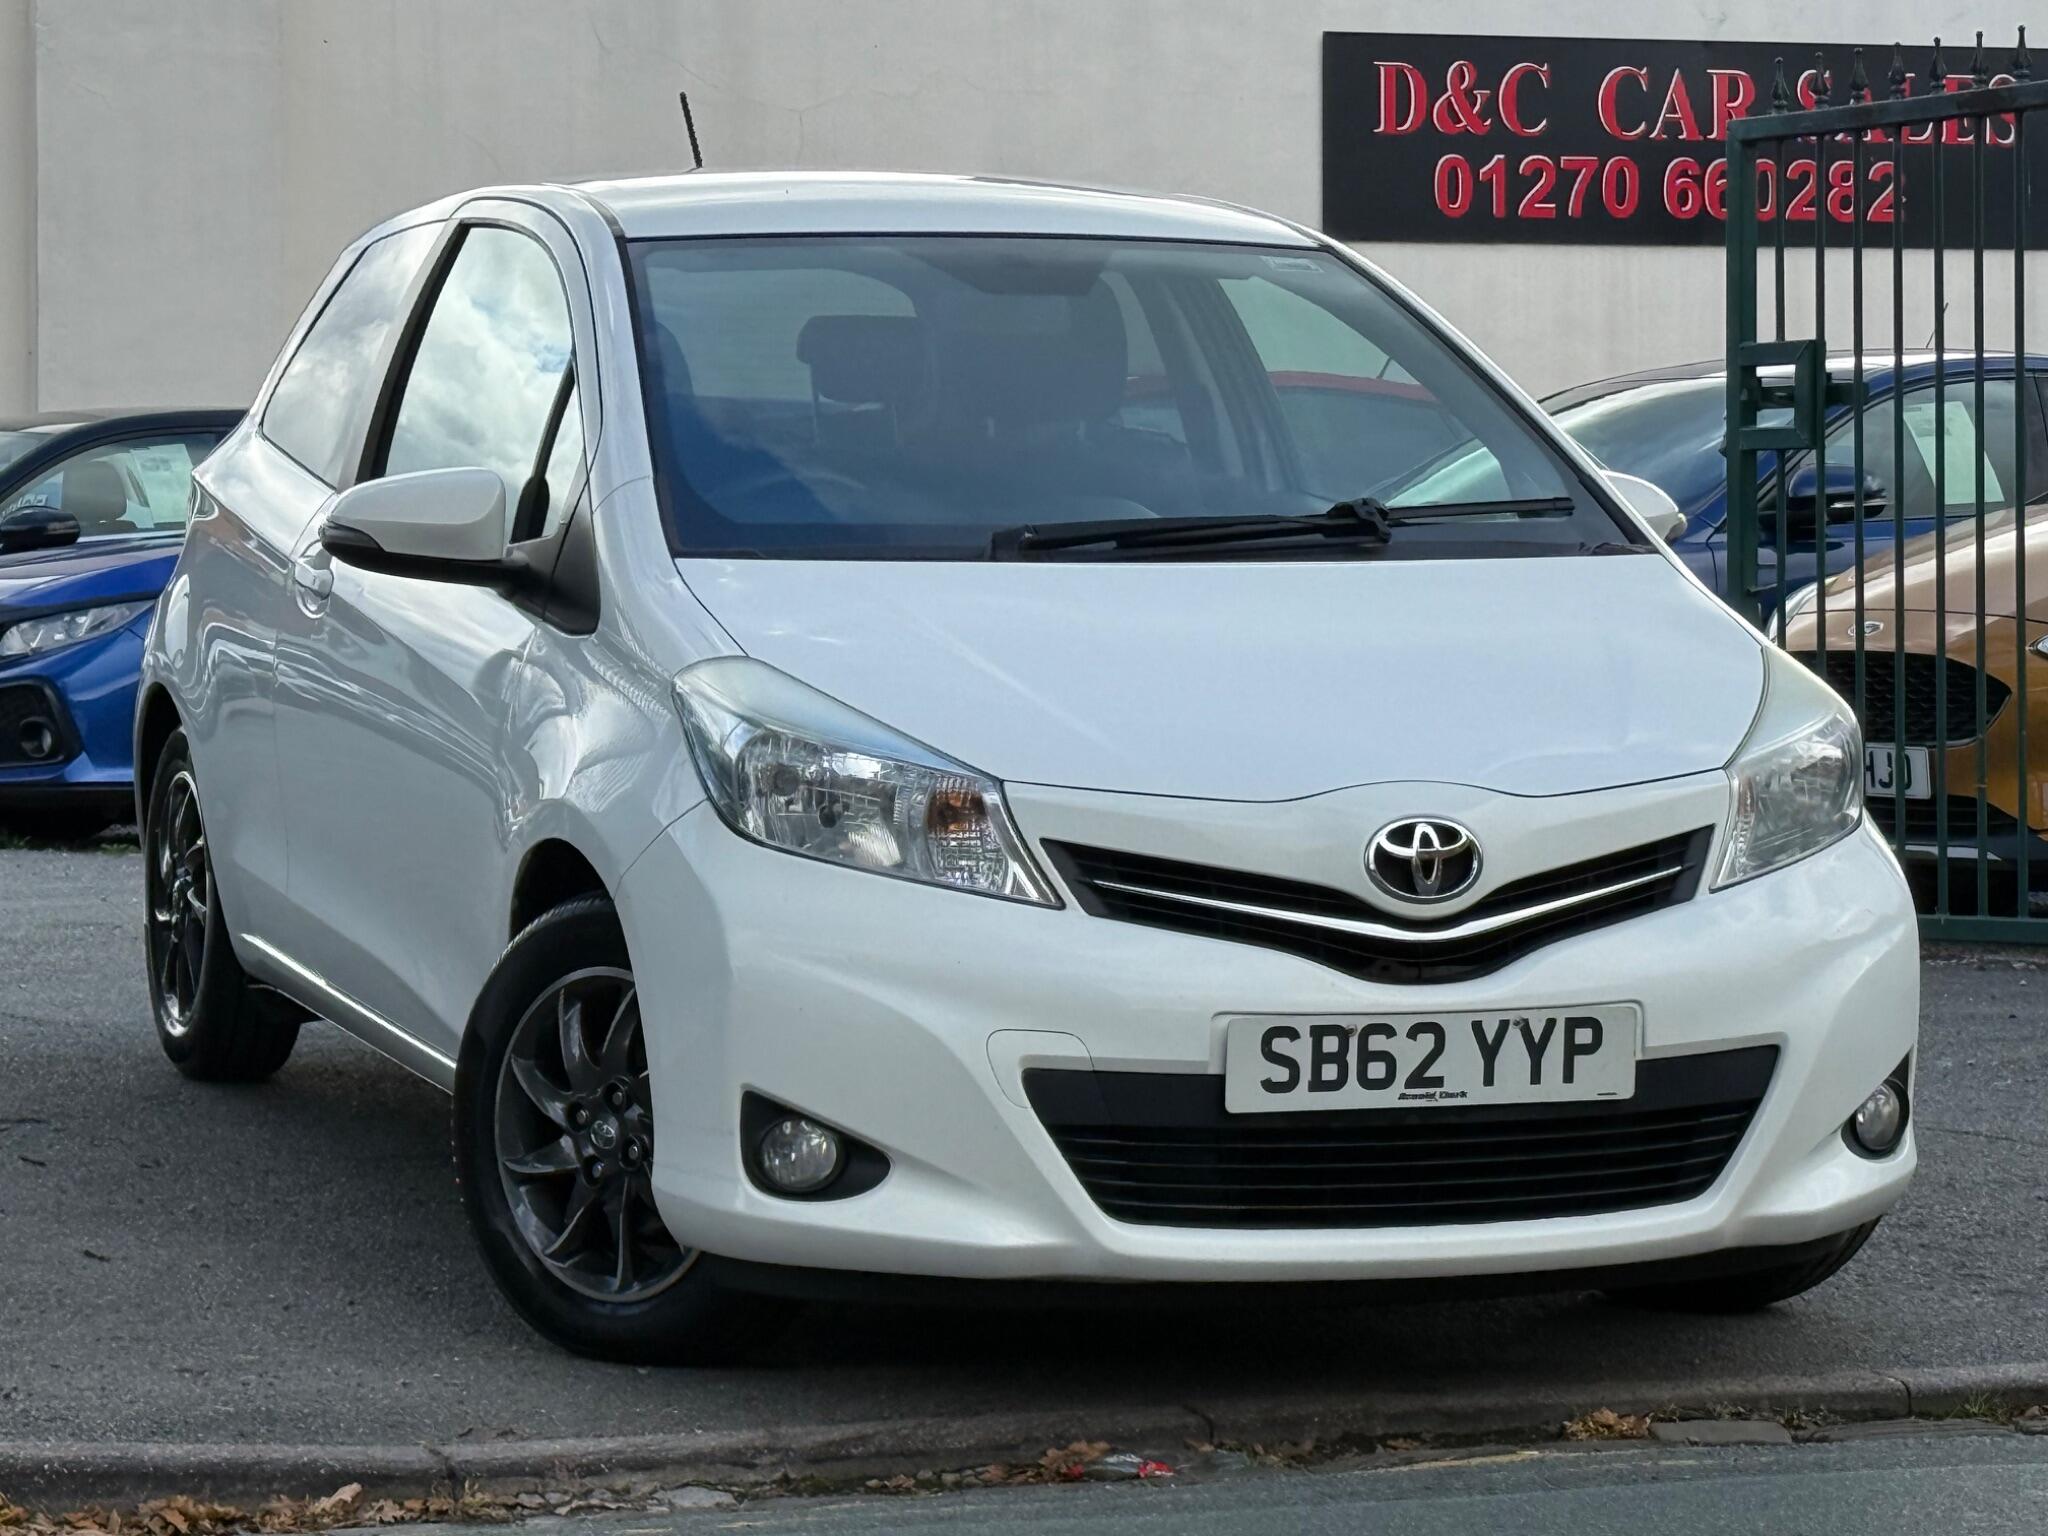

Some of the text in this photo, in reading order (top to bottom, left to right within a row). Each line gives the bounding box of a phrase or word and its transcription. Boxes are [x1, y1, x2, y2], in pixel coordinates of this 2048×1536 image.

[1373, 60, 1551, 137] D&C
[1598, 66, 1756, 142] CAR
[1433, 154, 1905, 223] 01270 660282
[1260, 1016, 1603, 1093] SB62 YYP
